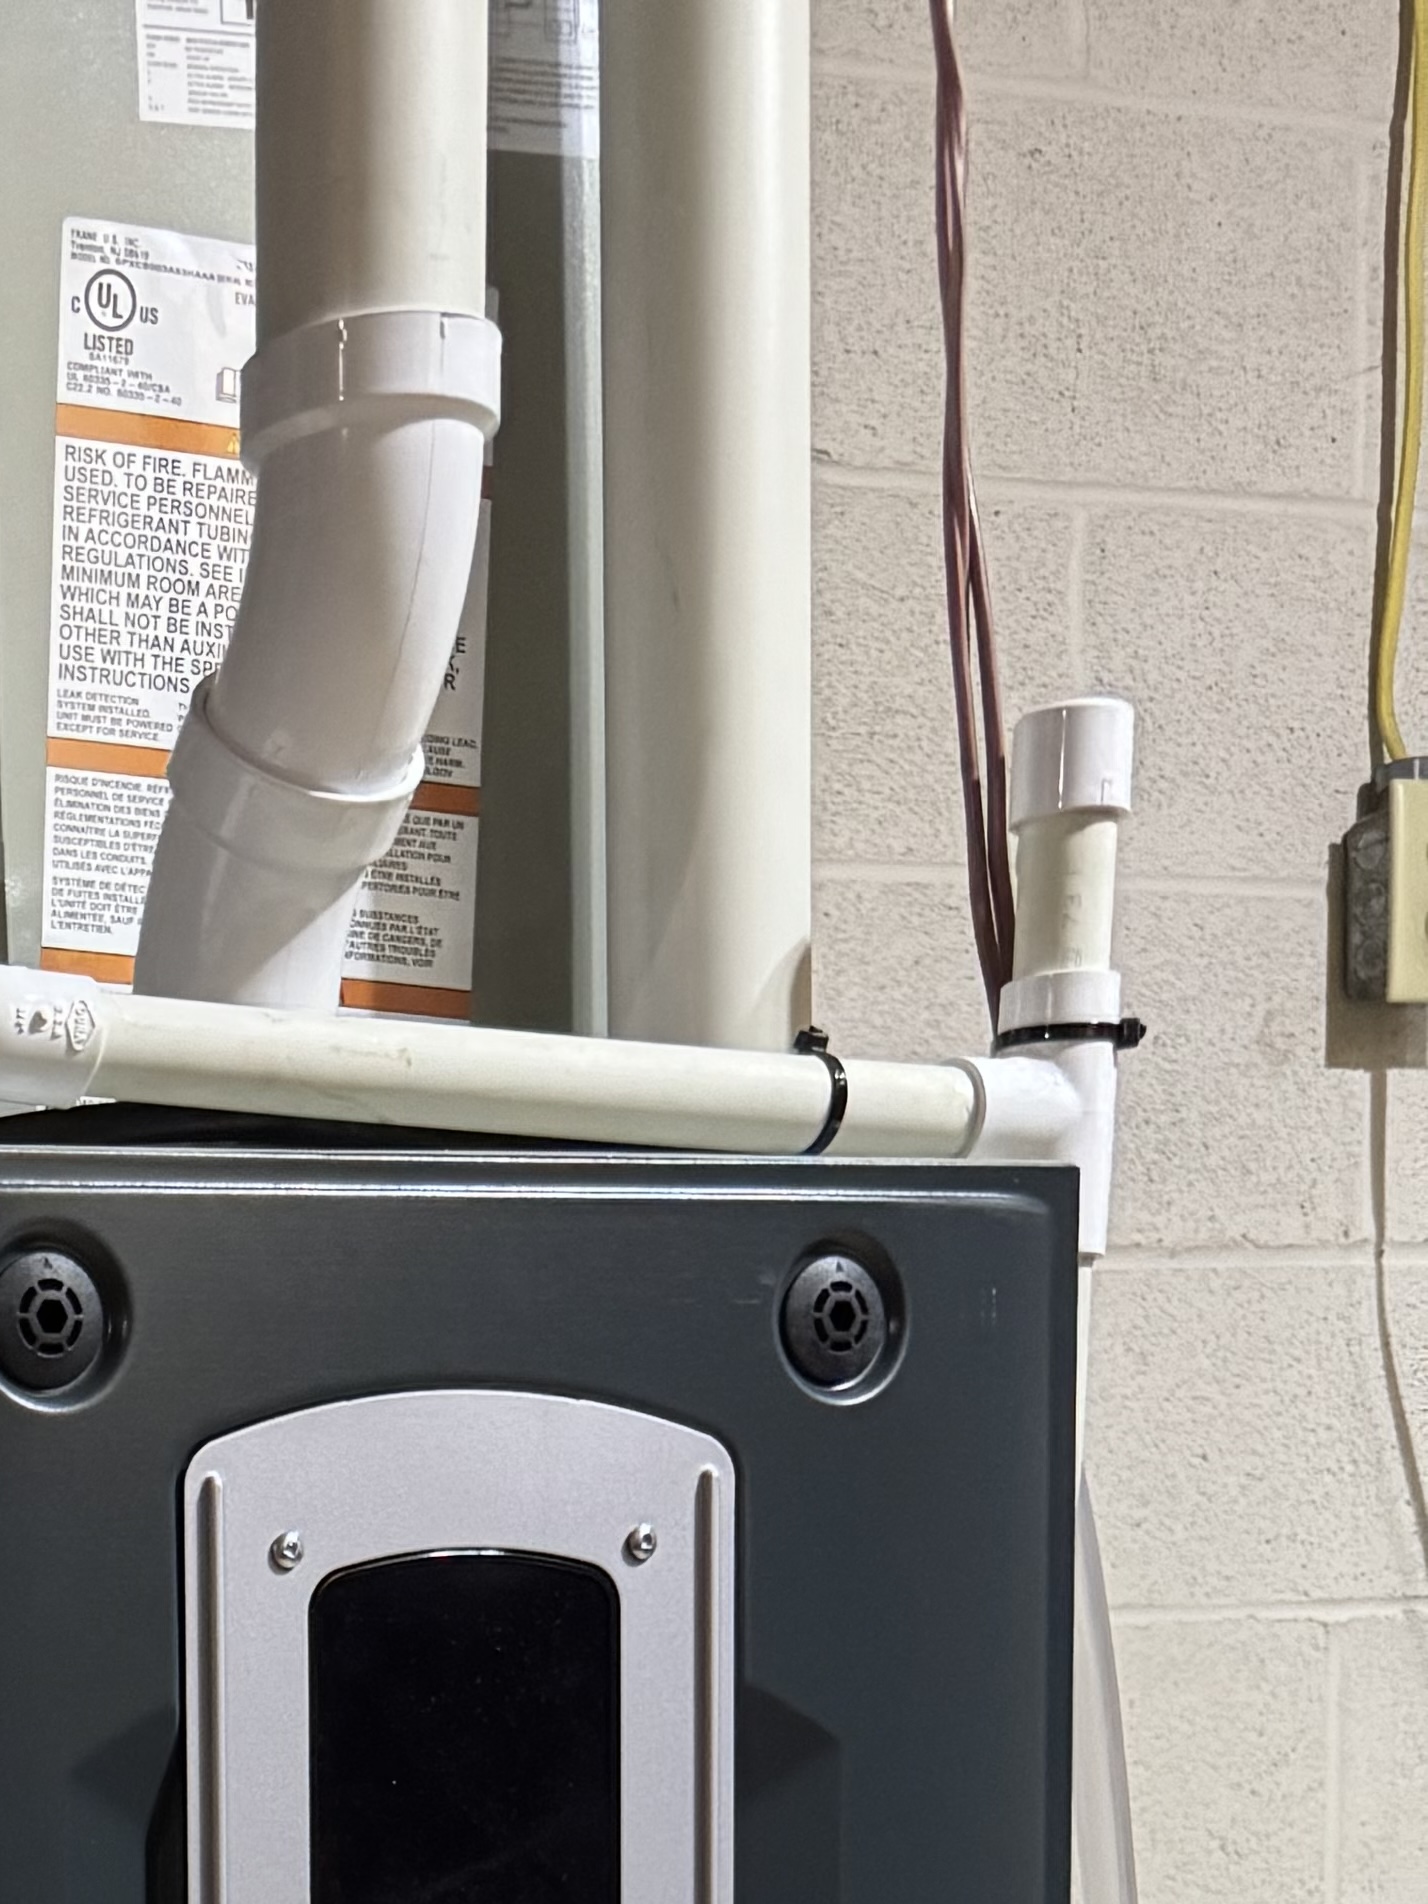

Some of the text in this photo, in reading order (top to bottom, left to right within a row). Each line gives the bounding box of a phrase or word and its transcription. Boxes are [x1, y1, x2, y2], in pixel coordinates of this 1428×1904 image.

[84, 333, 134, 356] LISTED
[67, 361, 153, 380] COMPLIANT WITH
[65, 444, 256, 486] RISK OF FIRE. FLAMM
[64, 464, 257, 506] USED. TO BE REPAIRE
[64, 485, 253, 525] SERVICE PERSONNEL
[63, 505, 252, 544] REFRIGERANT TUBIN
[63, 524, 212, 559] IN ACCORDANCE
[62, 544, 233, 581] REGULATIONS. SEE
[61, 564, 200, 596] MINIMUM ROOM
[60, 584, 209, 617] WHICH MAY BE A
[60, 604, 190, 635] SHALL NOT BE
[59, 624, 174, 651] OTHER THAN
[59, 644, 184, 673] USE WITH THE
[58, 663, 190, 694] INSTRUCTIONS
[57, 689, 139, 706] LEAK DETECTION
